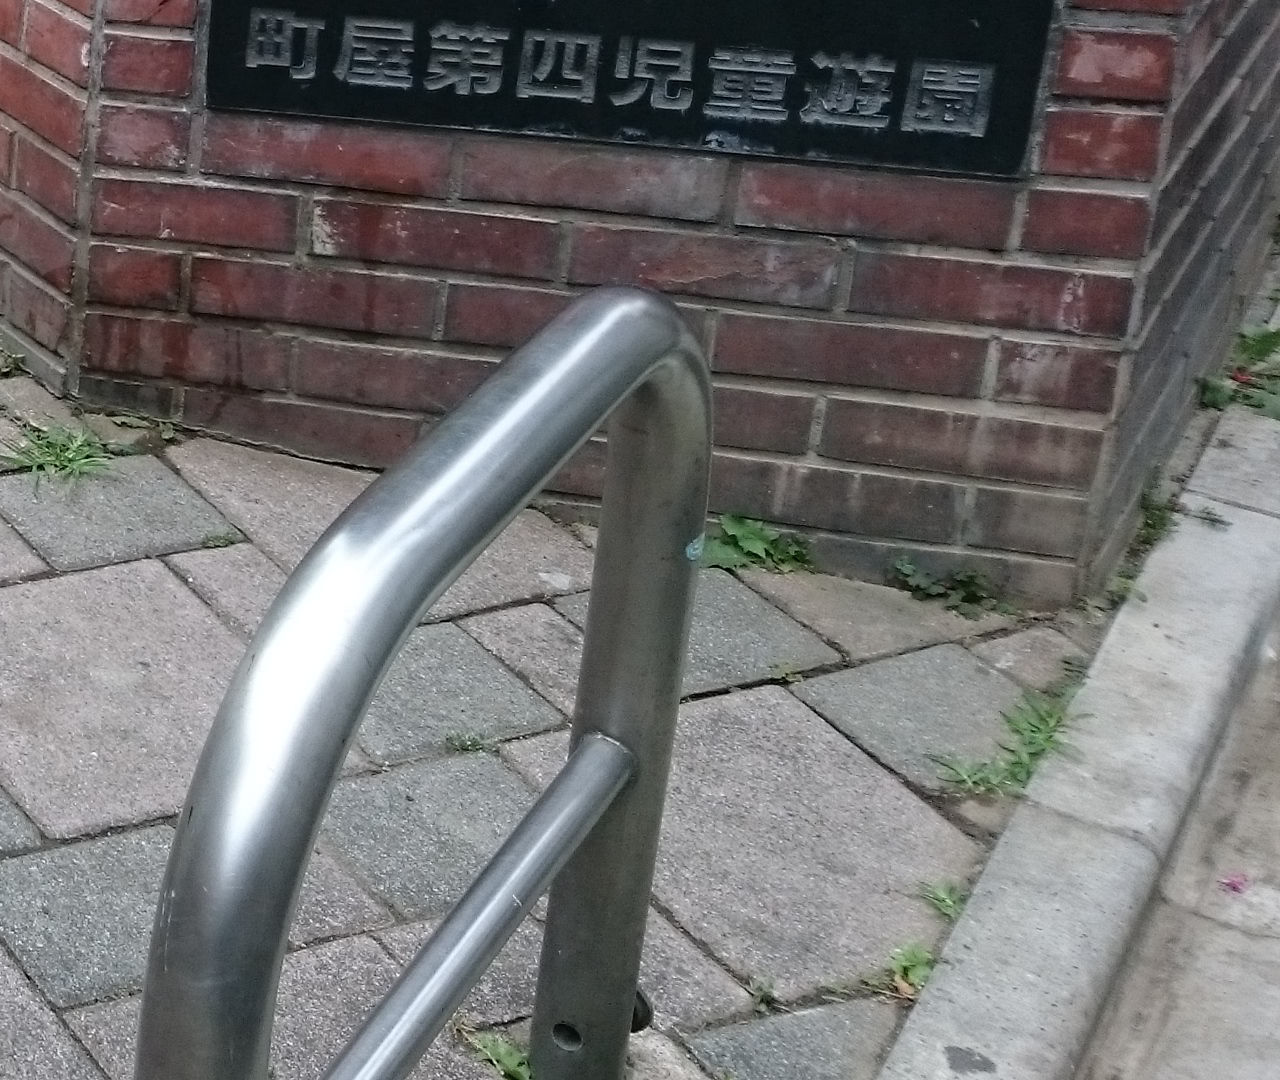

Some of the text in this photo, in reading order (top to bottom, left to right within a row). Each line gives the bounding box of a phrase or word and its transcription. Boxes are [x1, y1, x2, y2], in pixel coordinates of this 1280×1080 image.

[244, 8, 998, 139] 町屋第四児童遊園
